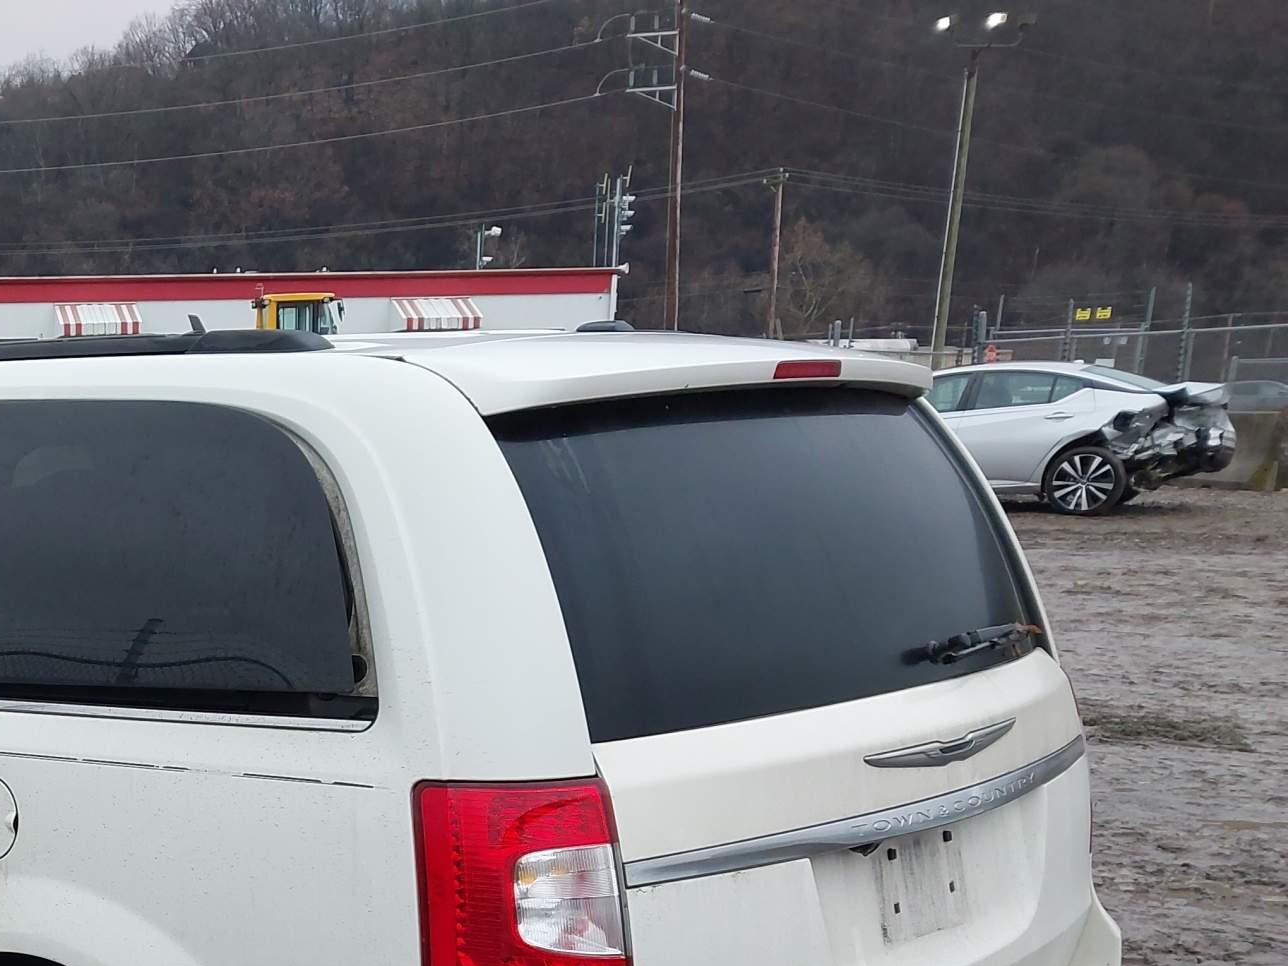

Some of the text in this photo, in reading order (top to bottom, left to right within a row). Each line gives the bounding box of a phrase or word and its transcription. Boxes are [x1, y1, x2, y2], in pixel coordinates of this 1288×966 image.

[851, 772, 1036, 837] TOWN & COUNTRY
